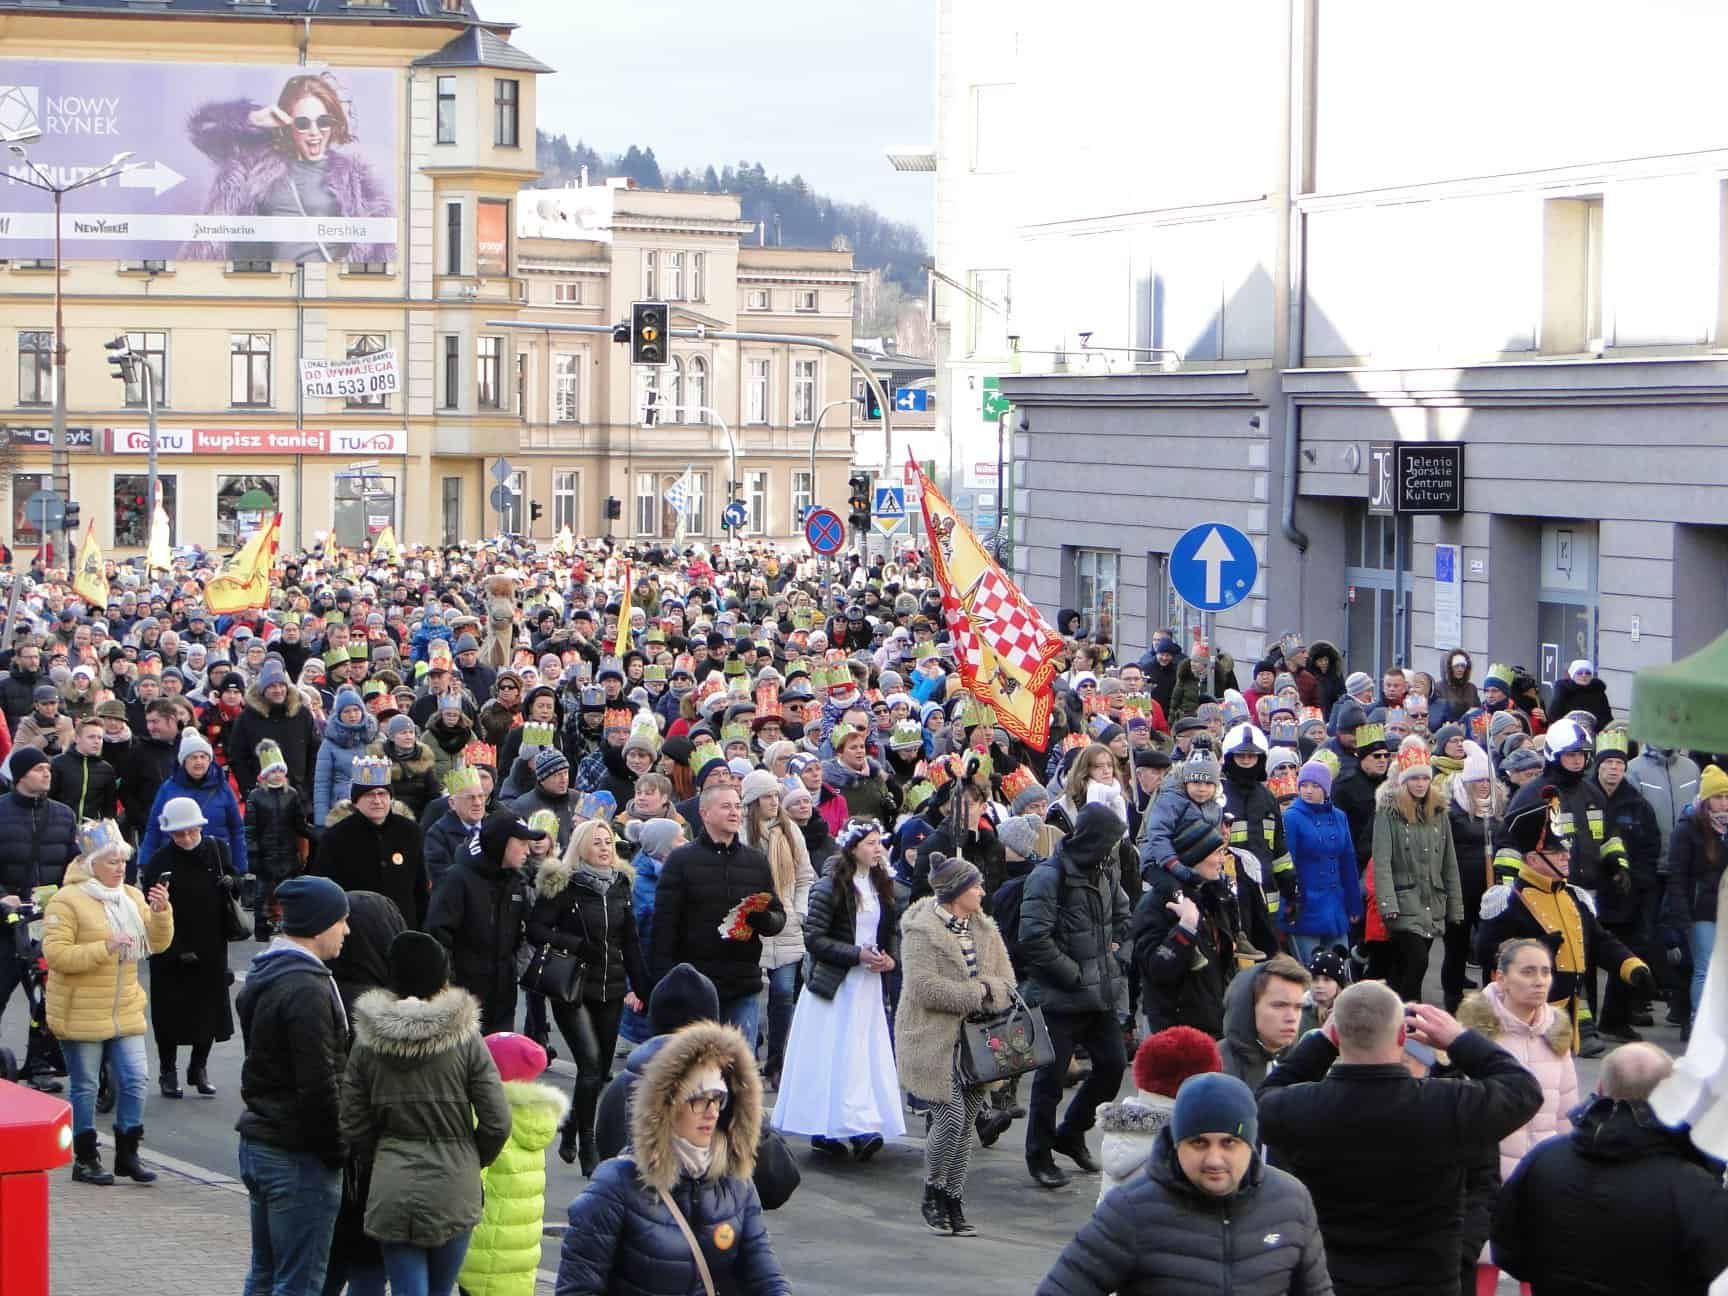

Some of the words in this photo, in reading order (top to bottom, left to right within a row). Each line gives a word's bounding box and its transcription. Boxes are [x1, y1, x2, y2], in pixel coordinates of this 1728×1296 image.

[47, 97, 120, 115] NOWY
[47, 116, 120, 135] RYNEK
[317, 224, 368, 237] Bershka
[305, 371, 321, 379] DO
[338, 378, 365, 394] 533
[370, 374, 395, 391] 089
[160, 436, 183, 449] TU
[198, 432, 262, 450] kupisz
[267, 432, 324, 450] taniej
[338, 437, 361, 450] TU
[1406, 456, 1453, 473] Jelenio
[1406, 476, 1453, 488] Centrum
[1406, 489, 1451, 502] Kultury
